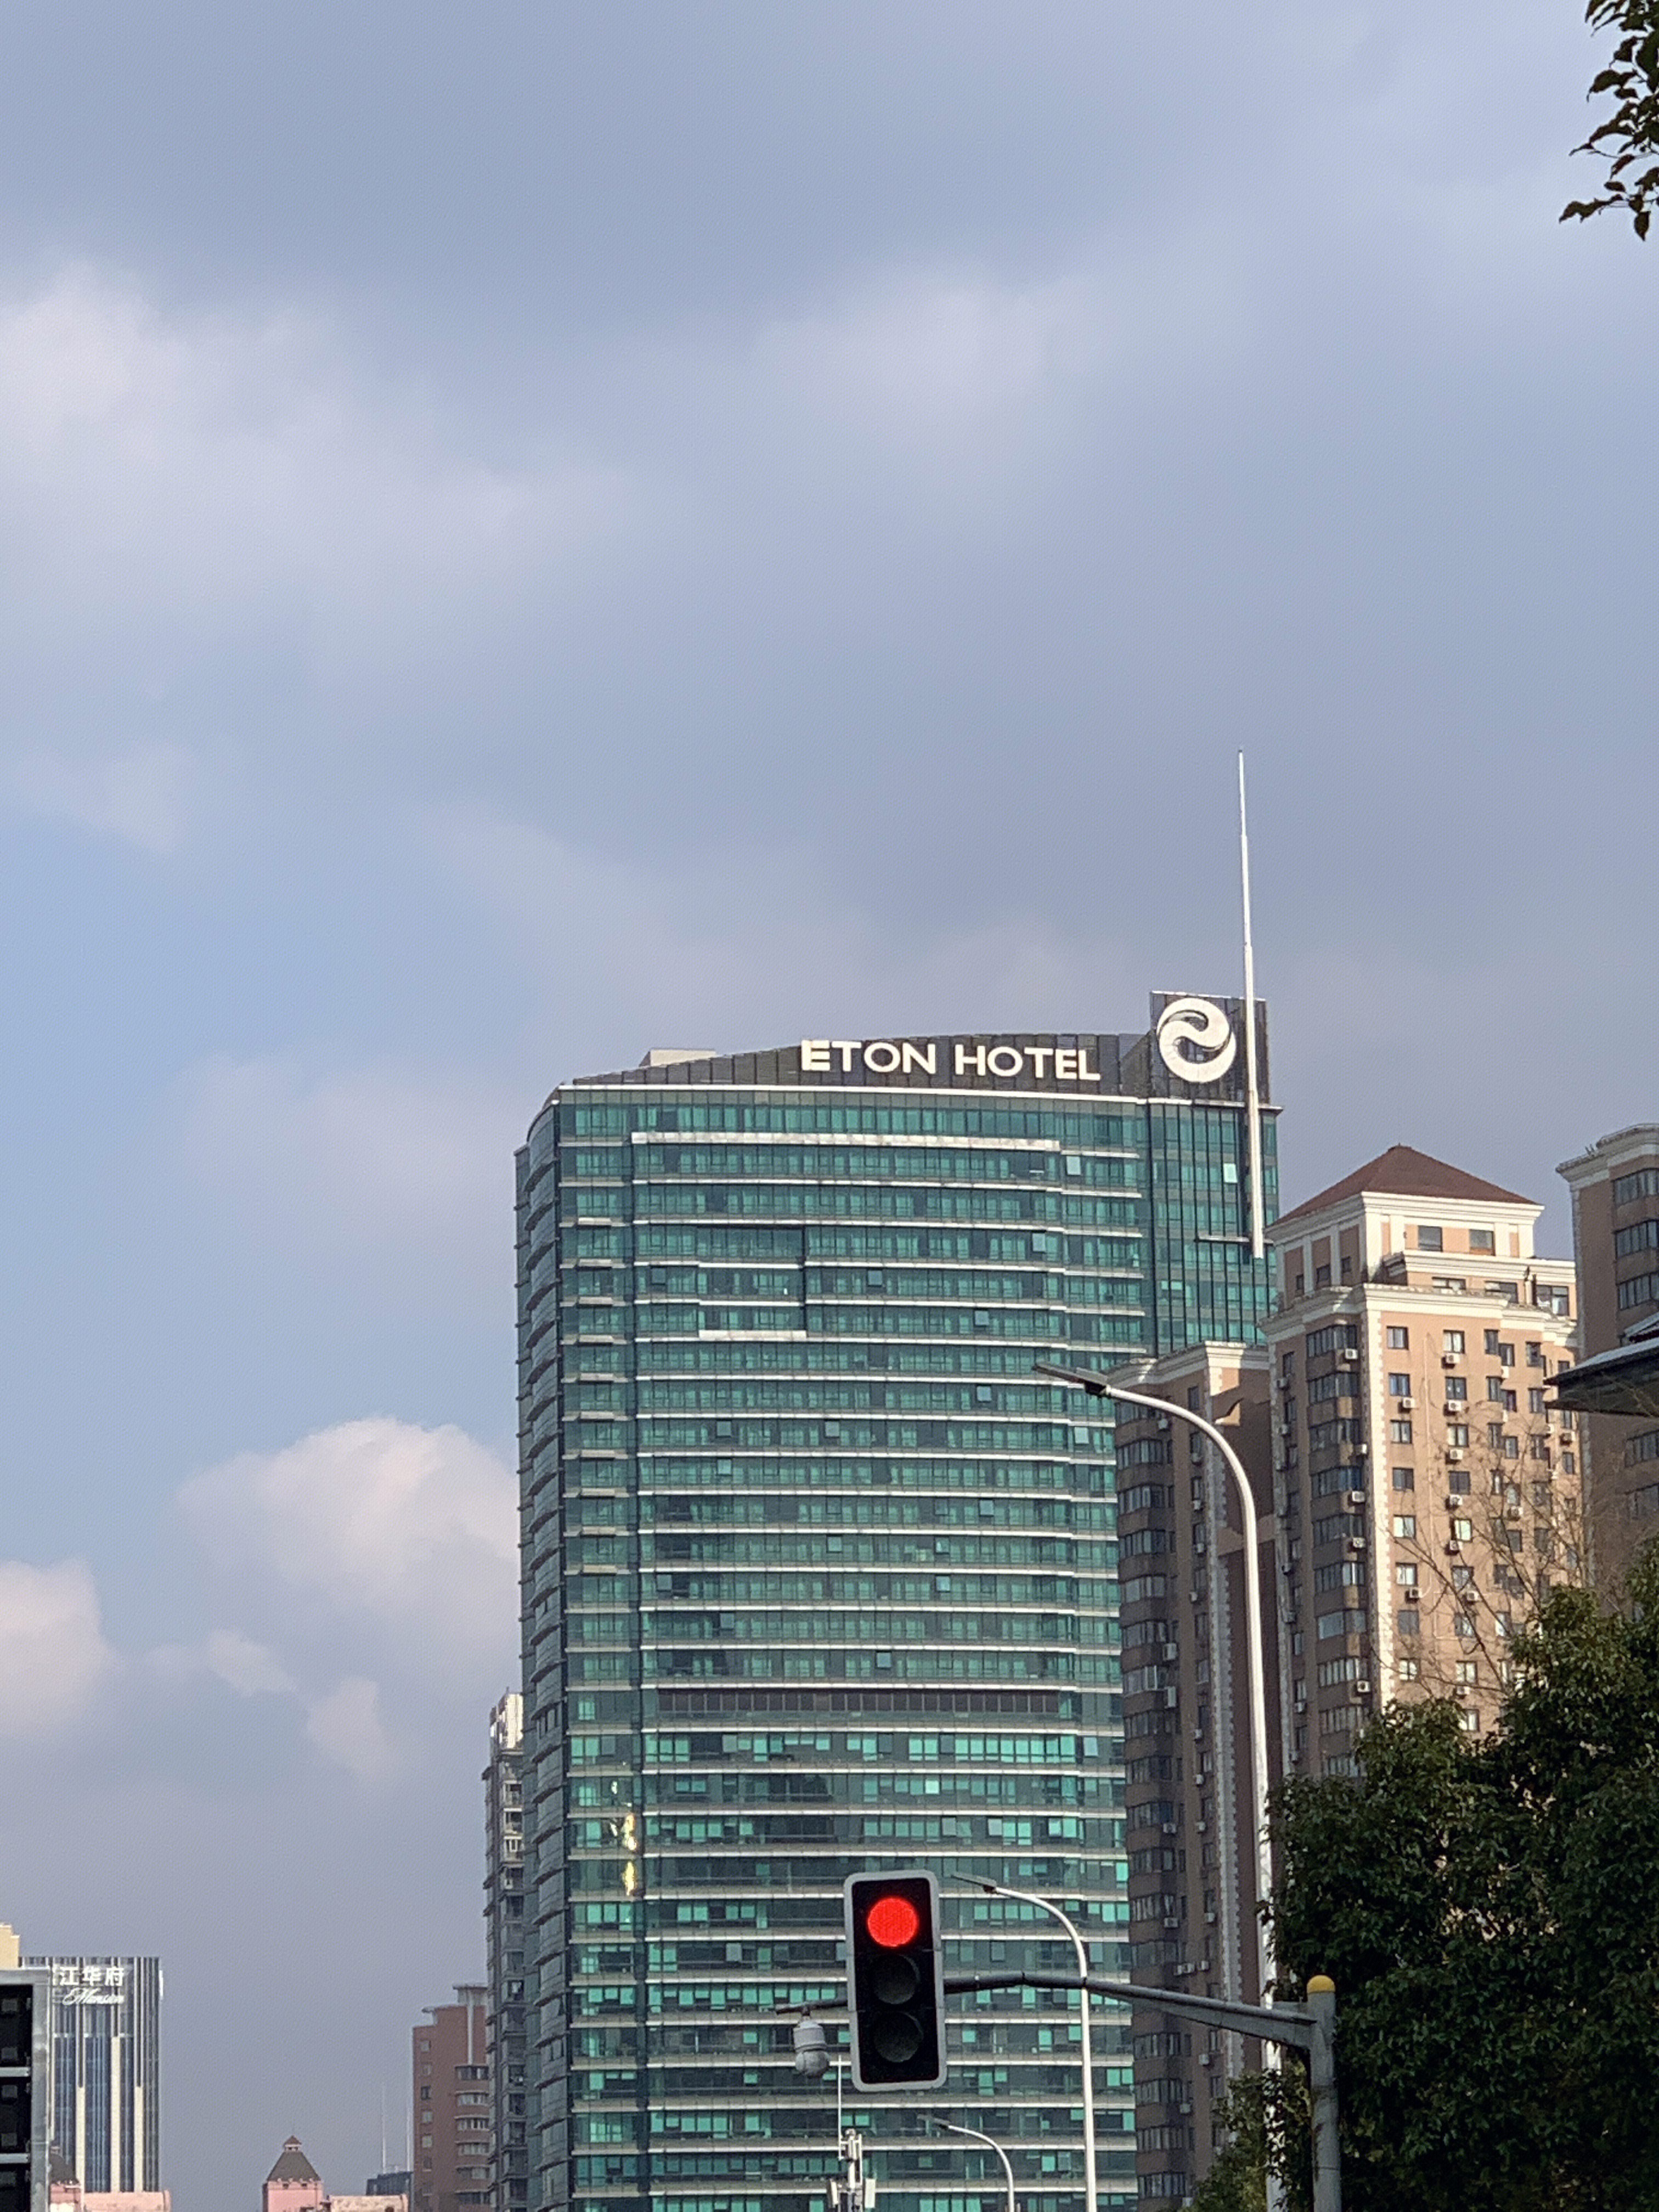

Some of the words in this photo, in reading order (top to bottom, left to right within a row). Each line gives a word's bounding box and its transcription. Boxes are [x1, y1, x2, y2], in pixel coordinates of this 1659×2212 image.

[800, 1039, 936, 1074] ETON
[955, 1044, 1101, 1081] HOTEL
[52, 1965, 124, 1986] 江华府
